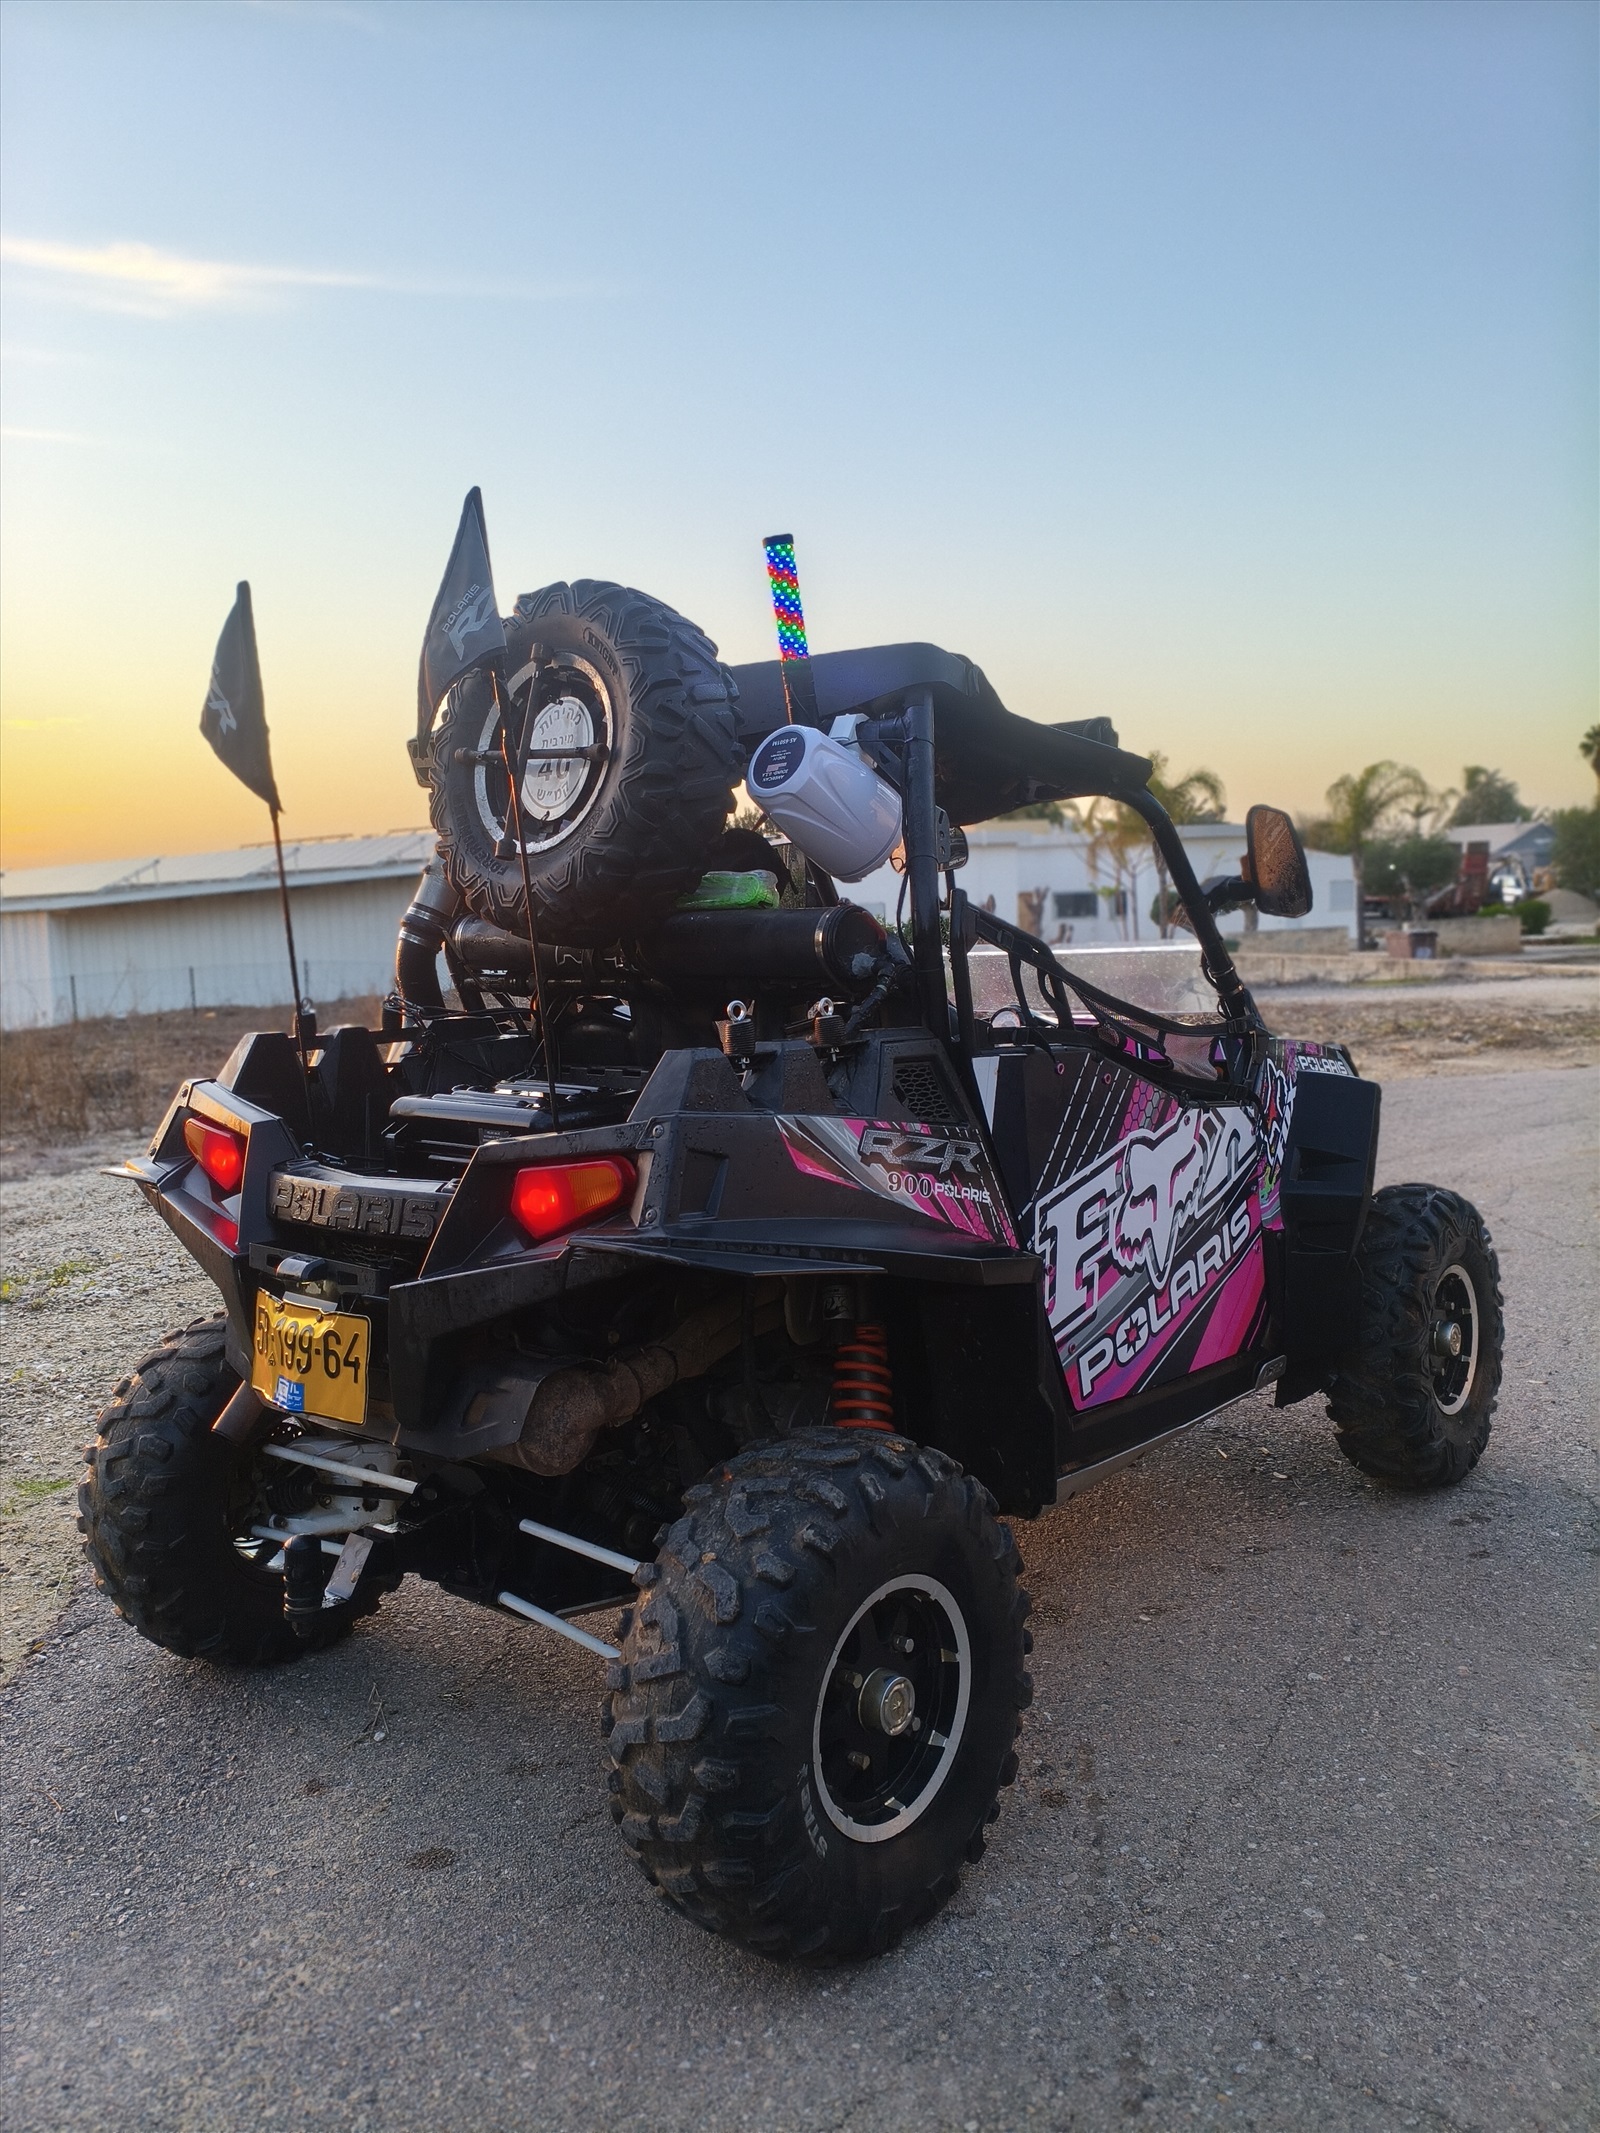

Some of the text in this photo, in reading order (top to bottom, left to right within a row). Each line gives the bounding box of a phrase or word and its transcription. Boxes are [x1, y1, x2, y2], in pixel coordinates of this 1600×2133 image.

[442, 583, 480, 633] POLARIS
[539, 706, 583, 735] מהירות
[540, 733, 575, 749] מירבית
[537, 758, 570, 781] 40
[1300, 1055, 1349, 1076] POLARIS
[859, 1128, 982, 1174] RZR
[887, 1171, 992, 1204] 900 POLARIS
[272, 1179, 439, 1239] POLARIS
[1078, 1204, 1251, 1398] POLARIS
[290, 1382, 300, 1394] IL
